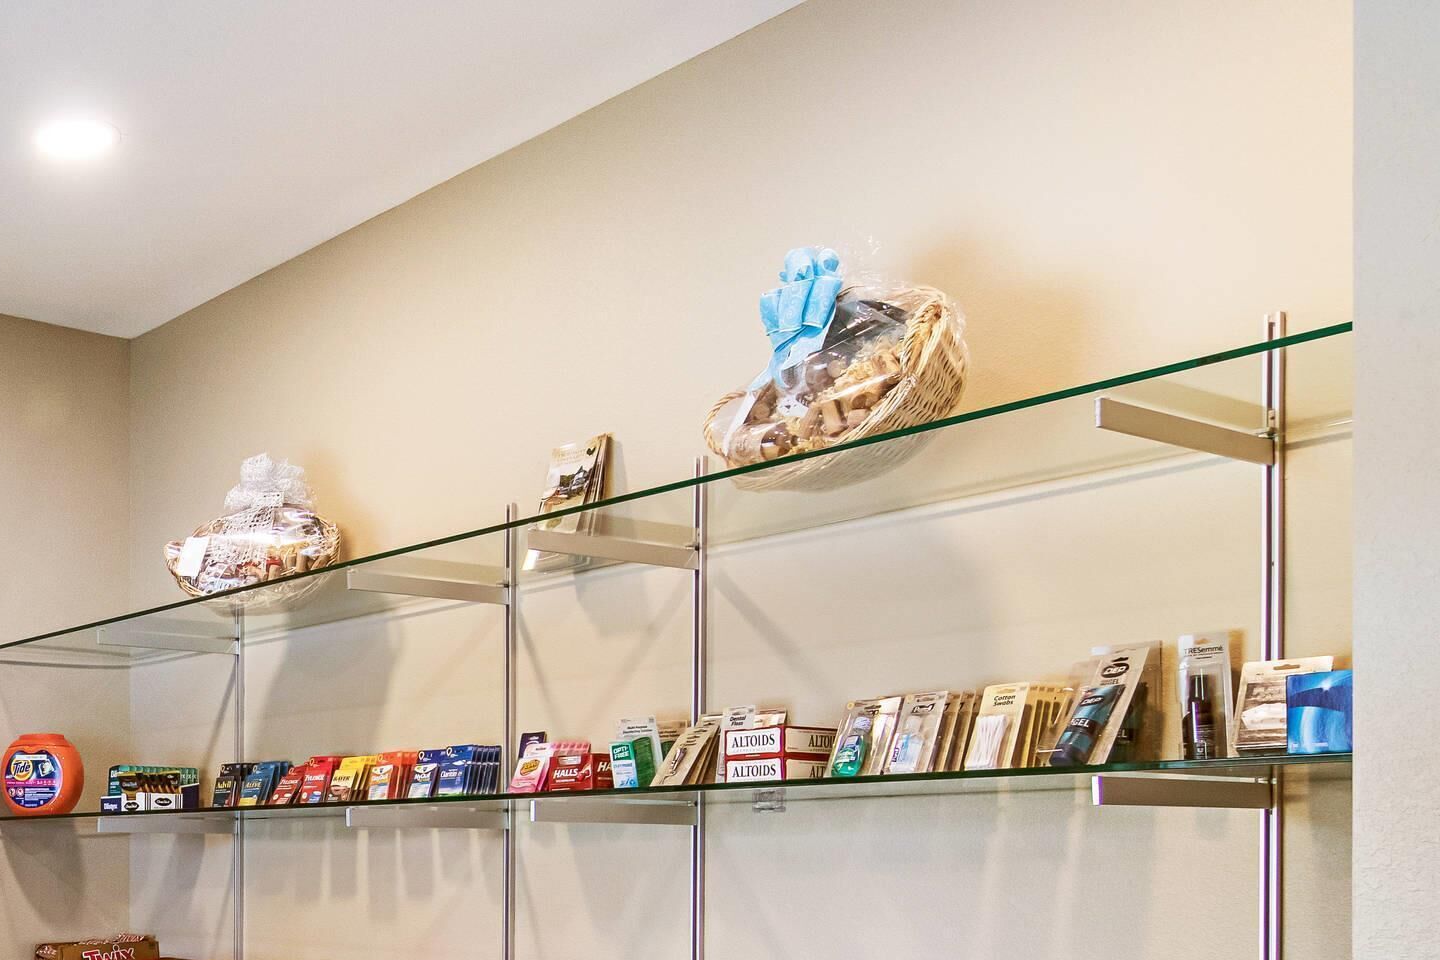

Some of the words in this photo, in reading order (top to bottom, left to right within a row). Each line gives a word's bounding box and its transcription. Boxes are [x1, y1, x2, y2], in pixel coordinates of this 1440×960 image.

[732, 733, 775, 748] ALTOIDS
[614, 751, 629, 759] FREE
[13, 761, 31, 776] Tide
[553, 768, 578, 779] HALLS
[732, 764, 776, 777] ALTOIDS
